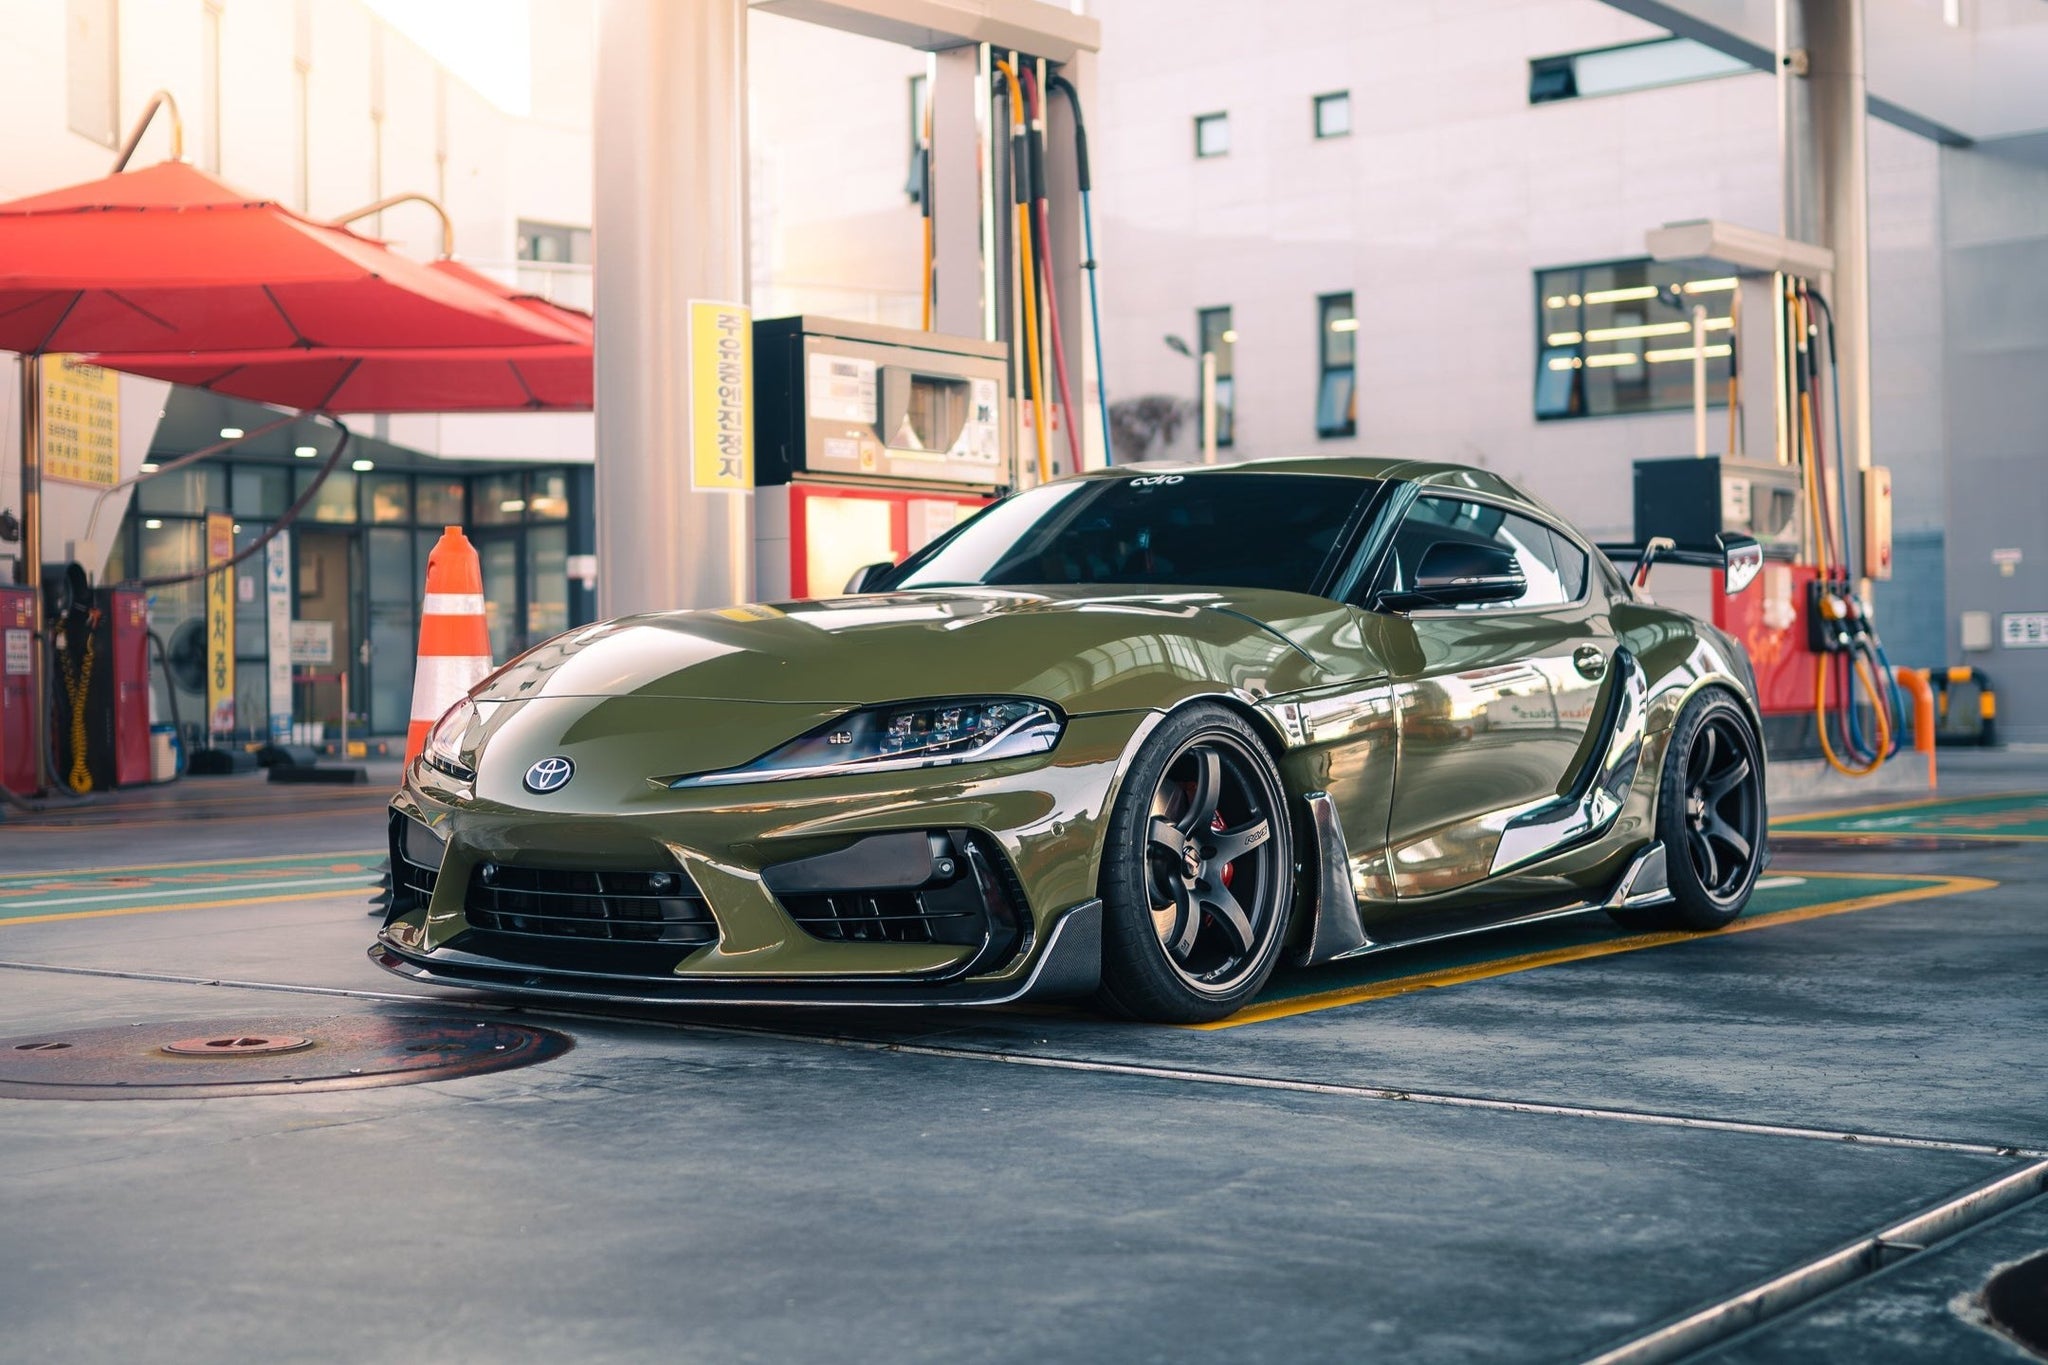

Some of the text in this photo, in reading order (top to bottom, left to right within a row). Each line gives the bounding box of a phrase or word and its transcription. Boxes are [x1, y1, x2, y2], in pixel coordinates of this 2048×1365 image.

[717, 314, 742, 479] 주유중엔진정지
[1130, 475, 1184, 486] adro
[1245, 826, 1268, 845] RAYS
